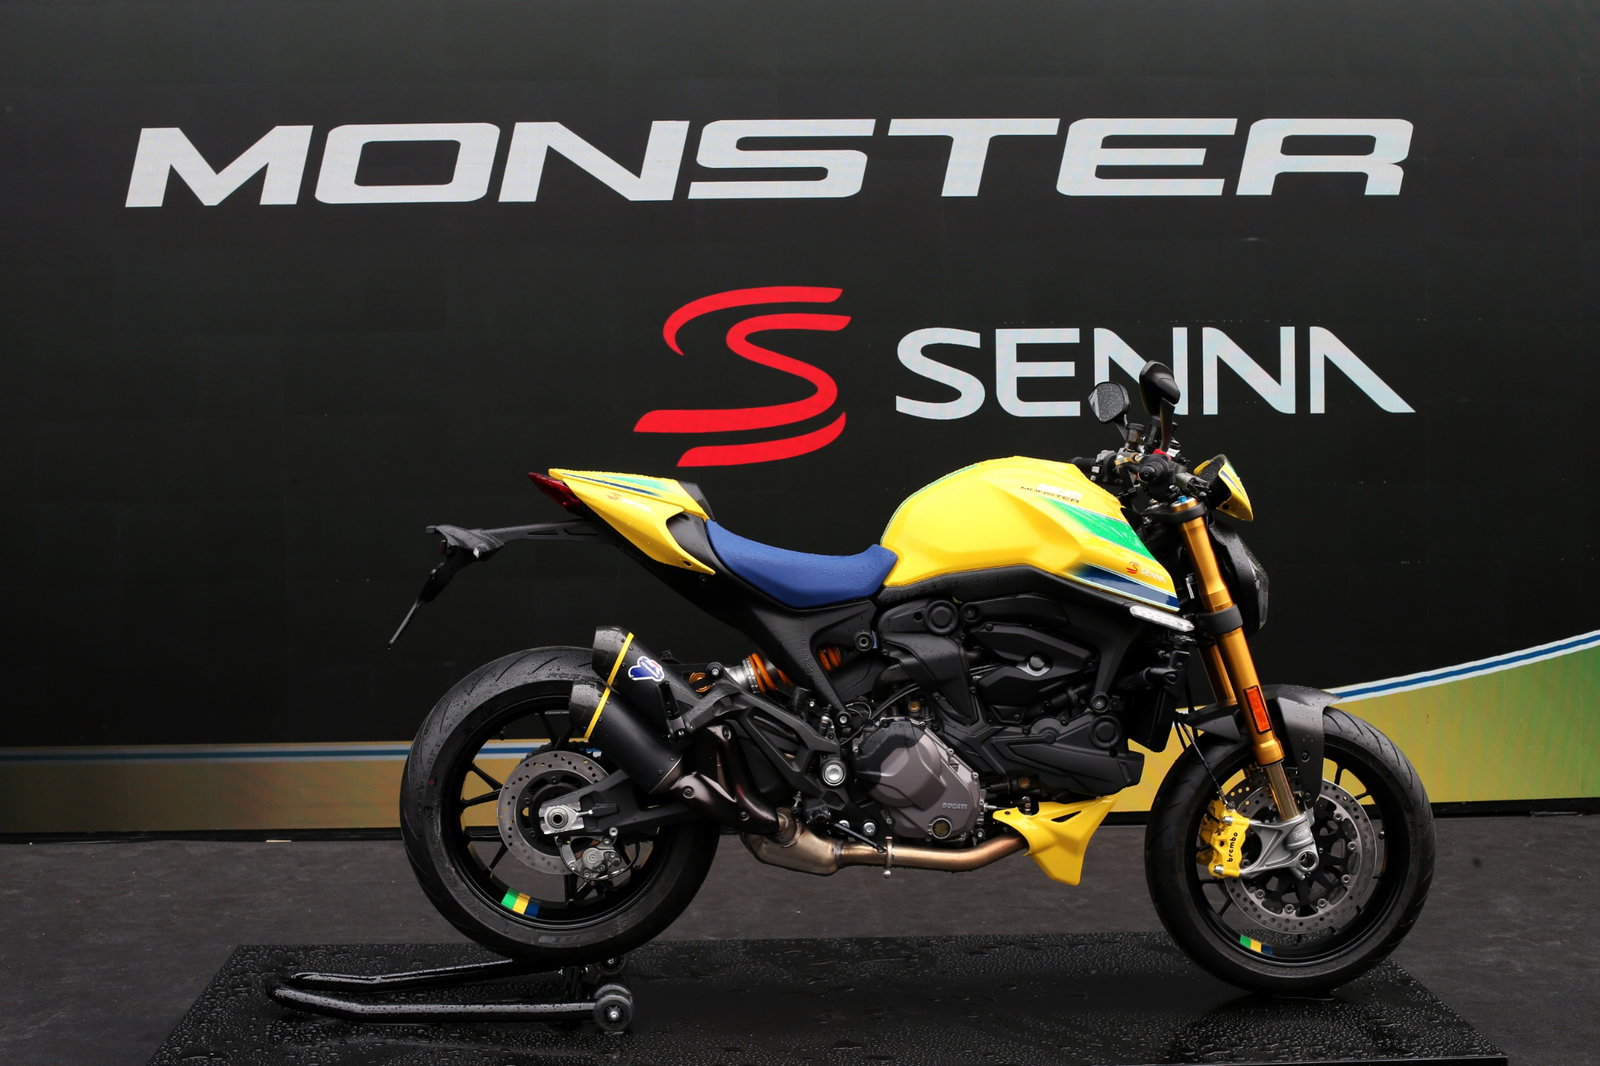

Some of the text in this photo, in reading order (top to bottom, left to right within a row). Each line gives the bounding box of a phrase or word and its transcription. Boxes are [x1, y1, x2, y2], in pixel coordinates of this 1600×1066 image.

[125, 118, 1413, 207] MONSTER
[896, 326, 1416, 419] SENNA
[1020, 486, 1079, 503] MONSTER
[942, 802, 968, 810] DUCATI
[1227, 832, 1238, 862] brembo
